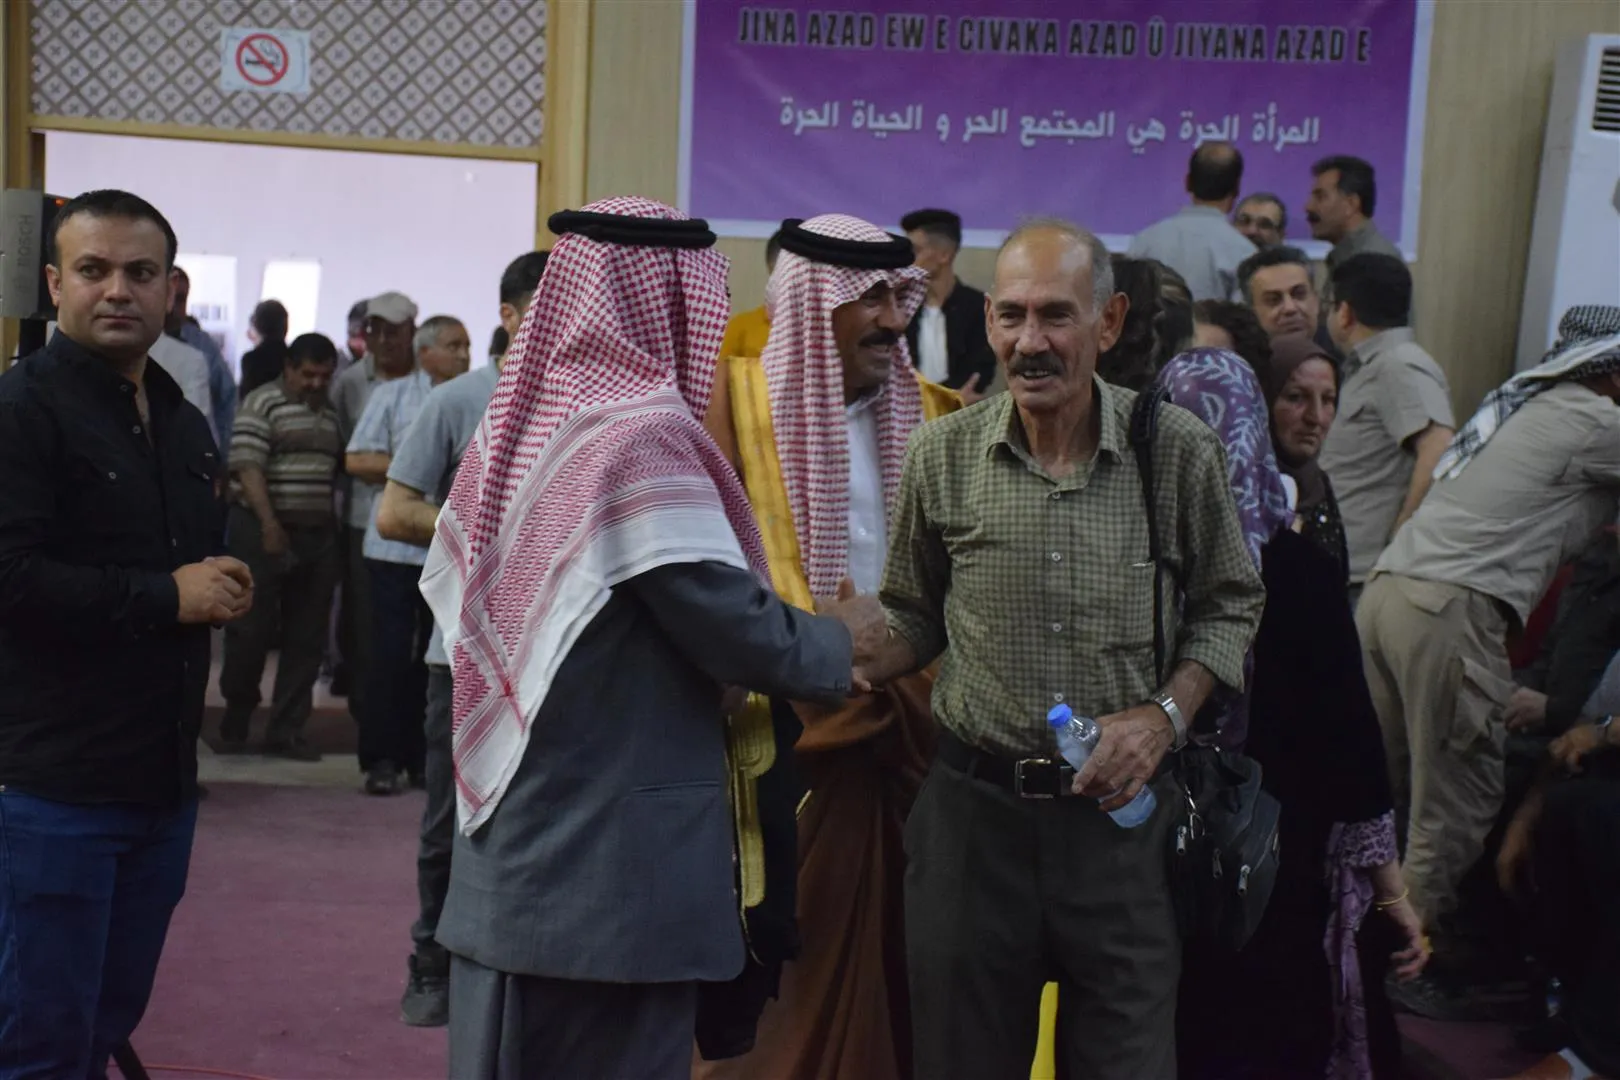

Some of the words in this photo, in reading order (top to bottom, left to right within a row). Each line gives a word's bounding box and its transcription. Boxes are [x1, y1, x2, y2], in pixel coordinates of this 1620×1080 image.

[740, 9, 796, 43] JINA
[807, 12, 875, 46] AZAD
[886, 16, 925, 49] EW
[936, 17, 948, 51] E
[959, 19, 1057, 54] CIVAKA
[1069, 22, 1137, 55] AZAD
[1148, 16, 1163, 57] Û
[1174, 24, 1265, 60] JIYANA
[1276, 27, 1345, 61] AZAD
[1357, 29, 1370, 62] E
[780, 96, 839, 136] الحرة
[851, 100, 923, 138] الحياة
[936, 113, 950, 141] و
[962, 108, 1008, 142] الحر
[1020, 110, 1115, 147] المجتمع
[1179, 111, 1240, 148] الحرة
[1251, 102, 1320, 152] المرأة
[1126, 117, 1166, 153] هي
